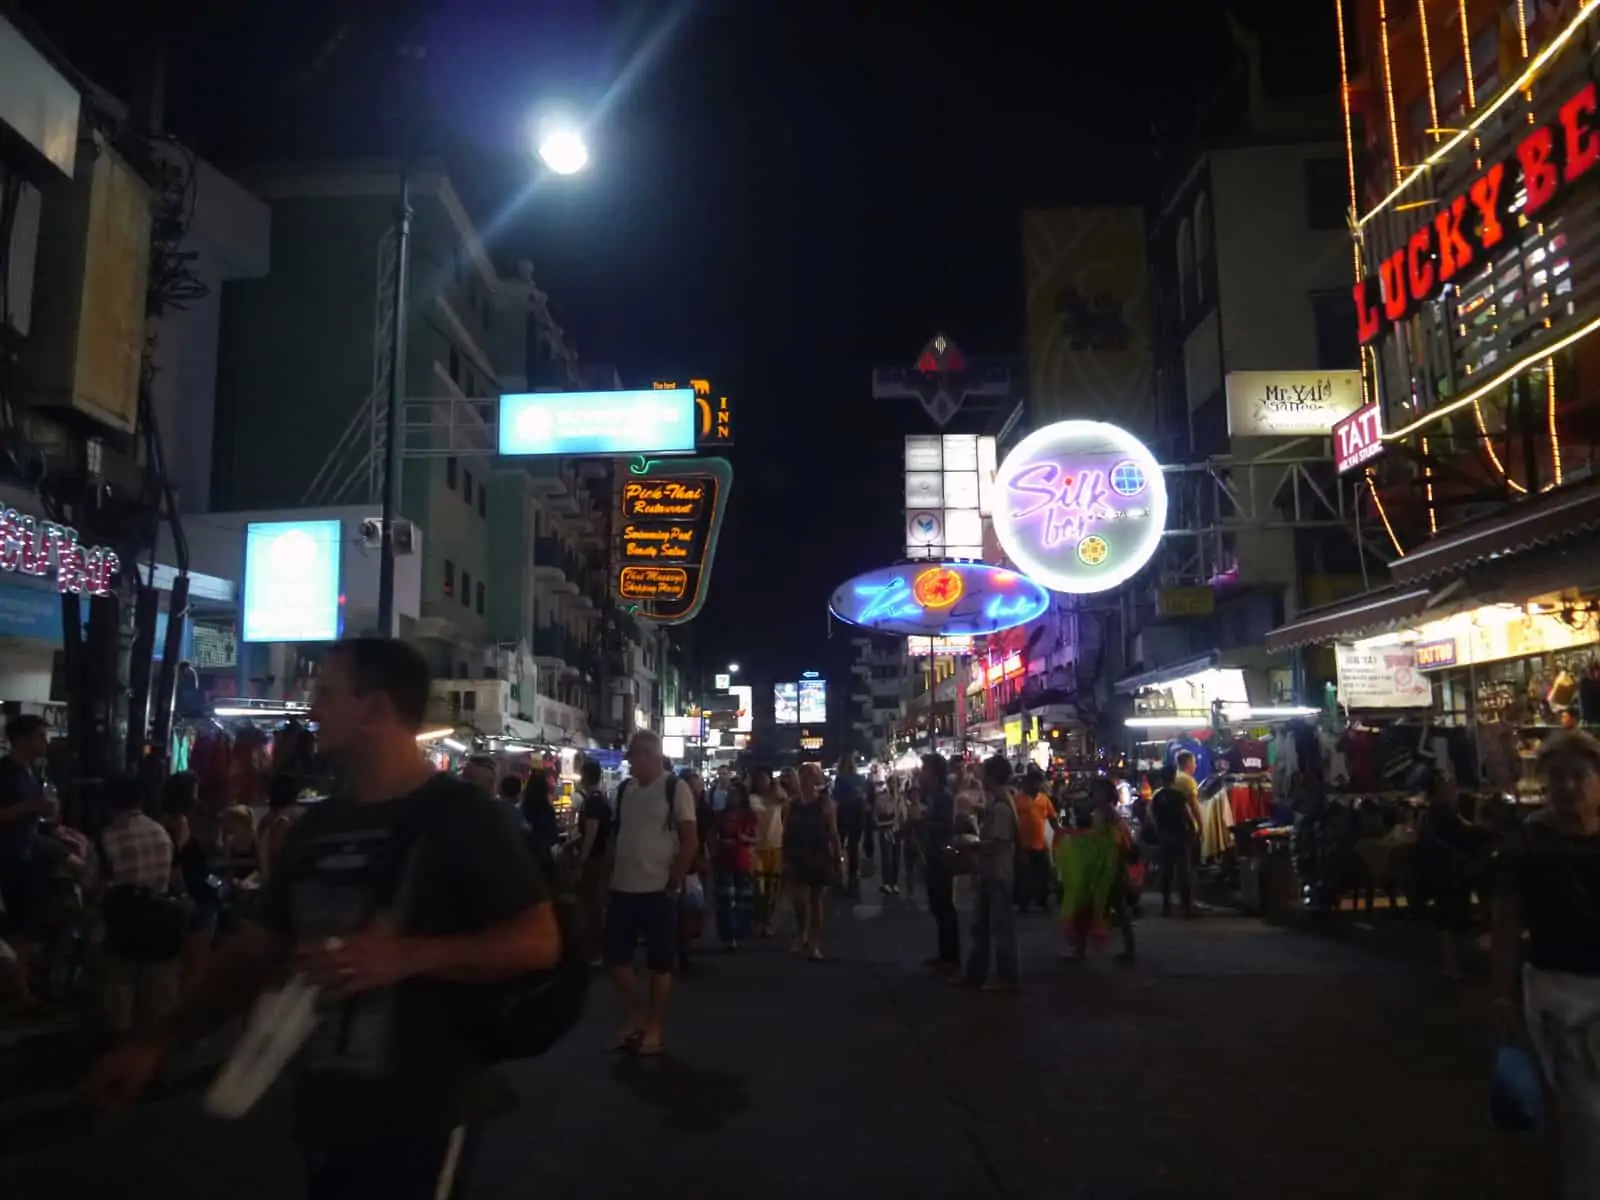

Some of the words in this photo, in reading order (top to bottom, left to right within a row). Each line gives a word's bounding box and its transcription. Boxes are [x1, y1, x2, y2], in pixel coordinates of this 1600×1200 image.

[1352, 162, 1504, 345] LUCKY
[717, 397, 729, 438] INN
[1008, 462, 1114, 519] Silk
